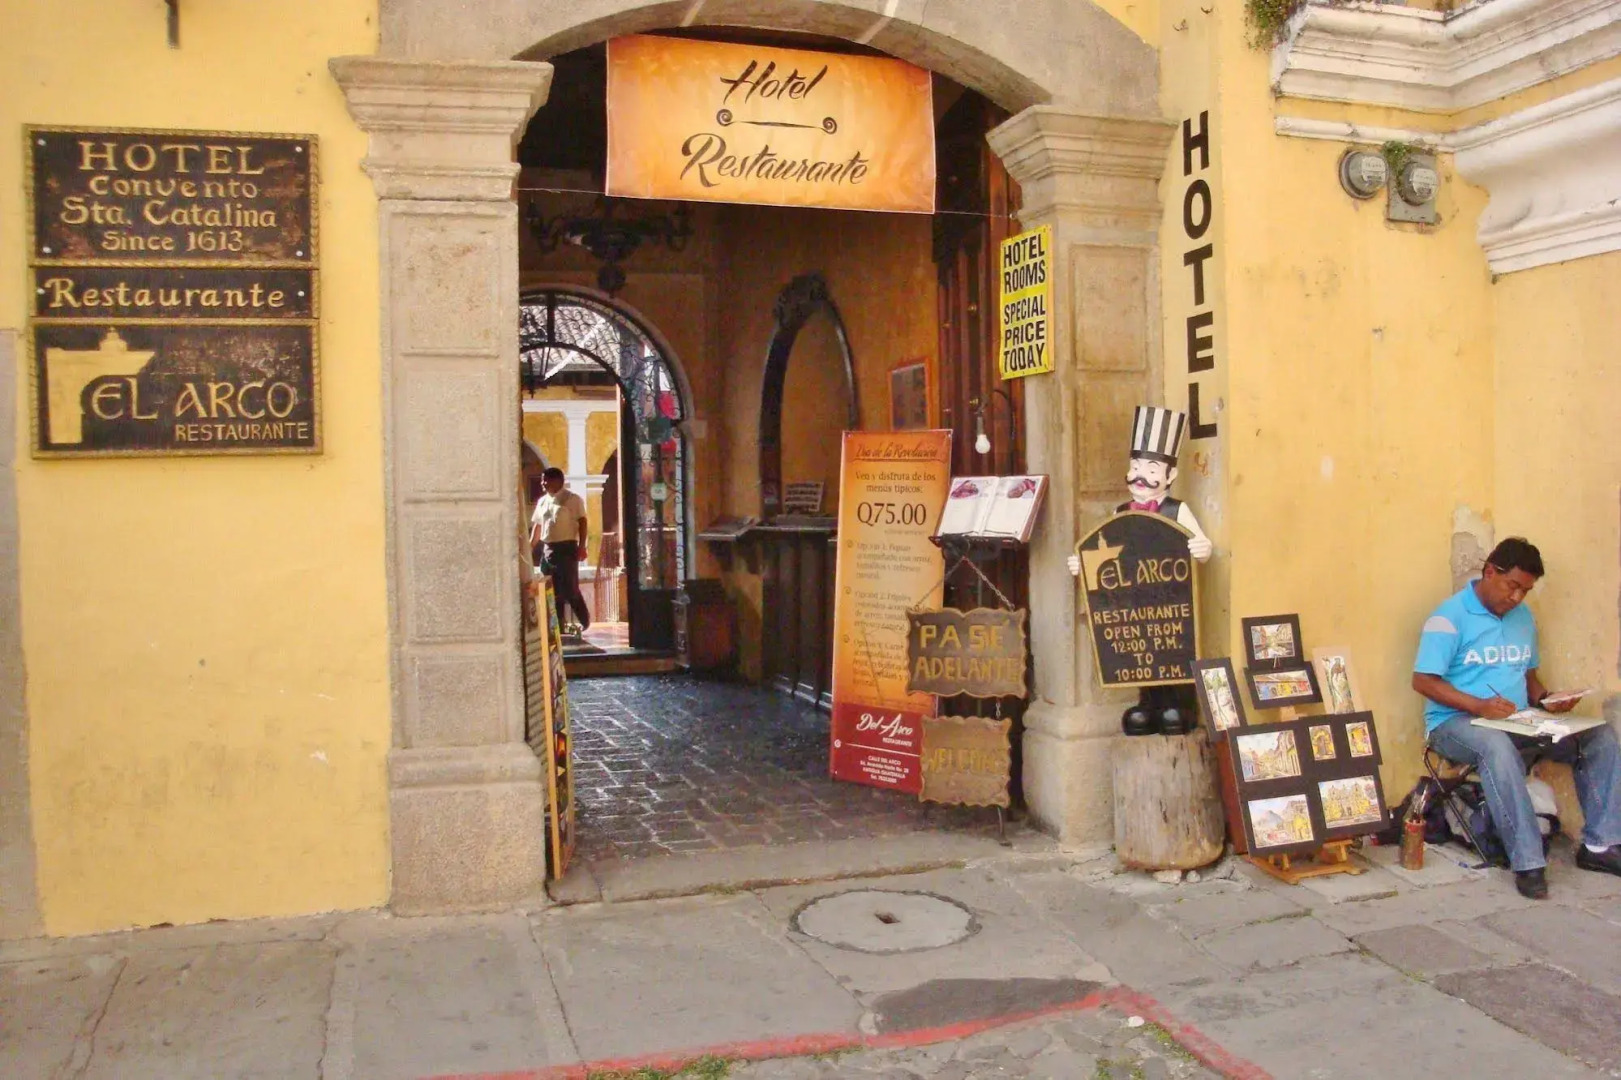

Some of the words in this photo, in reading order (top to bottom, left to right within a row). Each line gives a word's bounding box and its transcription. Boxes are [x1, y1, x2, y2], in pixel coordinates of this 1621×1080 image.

[720, 59, 828, 104] Hotel
[78, 141, 265, 175] HOTEL
[680, 132, 869, 188] Restaurante
[90, 175, 258, 199] Convento
[60, 197, 132, 226] Sta.
[144, 200, 277, 228] Catalina
[102, 231, 175, 252] Since
[187, 231, 244, 252] 1613
[1003, 233, 1045, 268] HOTEL
[1004, 262, 1046, 294] ROOMS
[1182, 110, 1218, 440] HOTEL
[44, 278, 285, 309] Restaurante
[1003, 294, 1046, 326] SPECIAL
[1004, 320, 1046, 348] PRICE
[1003, 343, 1045, 373] TODAY
[91, 377, 158, 421] EL
[174, 381, 296, 419] ARCO
[175, 422, 309, 441] RESTAURANTE
[879, 471, 910, 481] disfruta
[912, 471, 922, 481] de
[923, 471, 936, 481] los
[857, 502, 927, 527] Q75.00
[1100, 558, 1132, 590] EL
[1136, 558, 1189, 584] ARCO
[1093, 603, 1190, 625] RESTAURANTE
[921, 624, 1004, 651] PASE
[1104, 625, 1141, 640] OPEN
[1146, 622, 1183, 636] FROM
[1111, 638, 1146, 654] 12:00
[1154, 636, 1183, 650] P.M.
[1463, 644, 1532, 665] ADIDA
[914, 656, 1020, 683] ADELANTE
[1133, 653, 1154, 666] TO
[1114, 667, 1152, 682] 10:00
[1159, 665, 1186, 679] P.M.
[856, 713, 884, 731] Del
[878, 713, 913, 737] Arco
